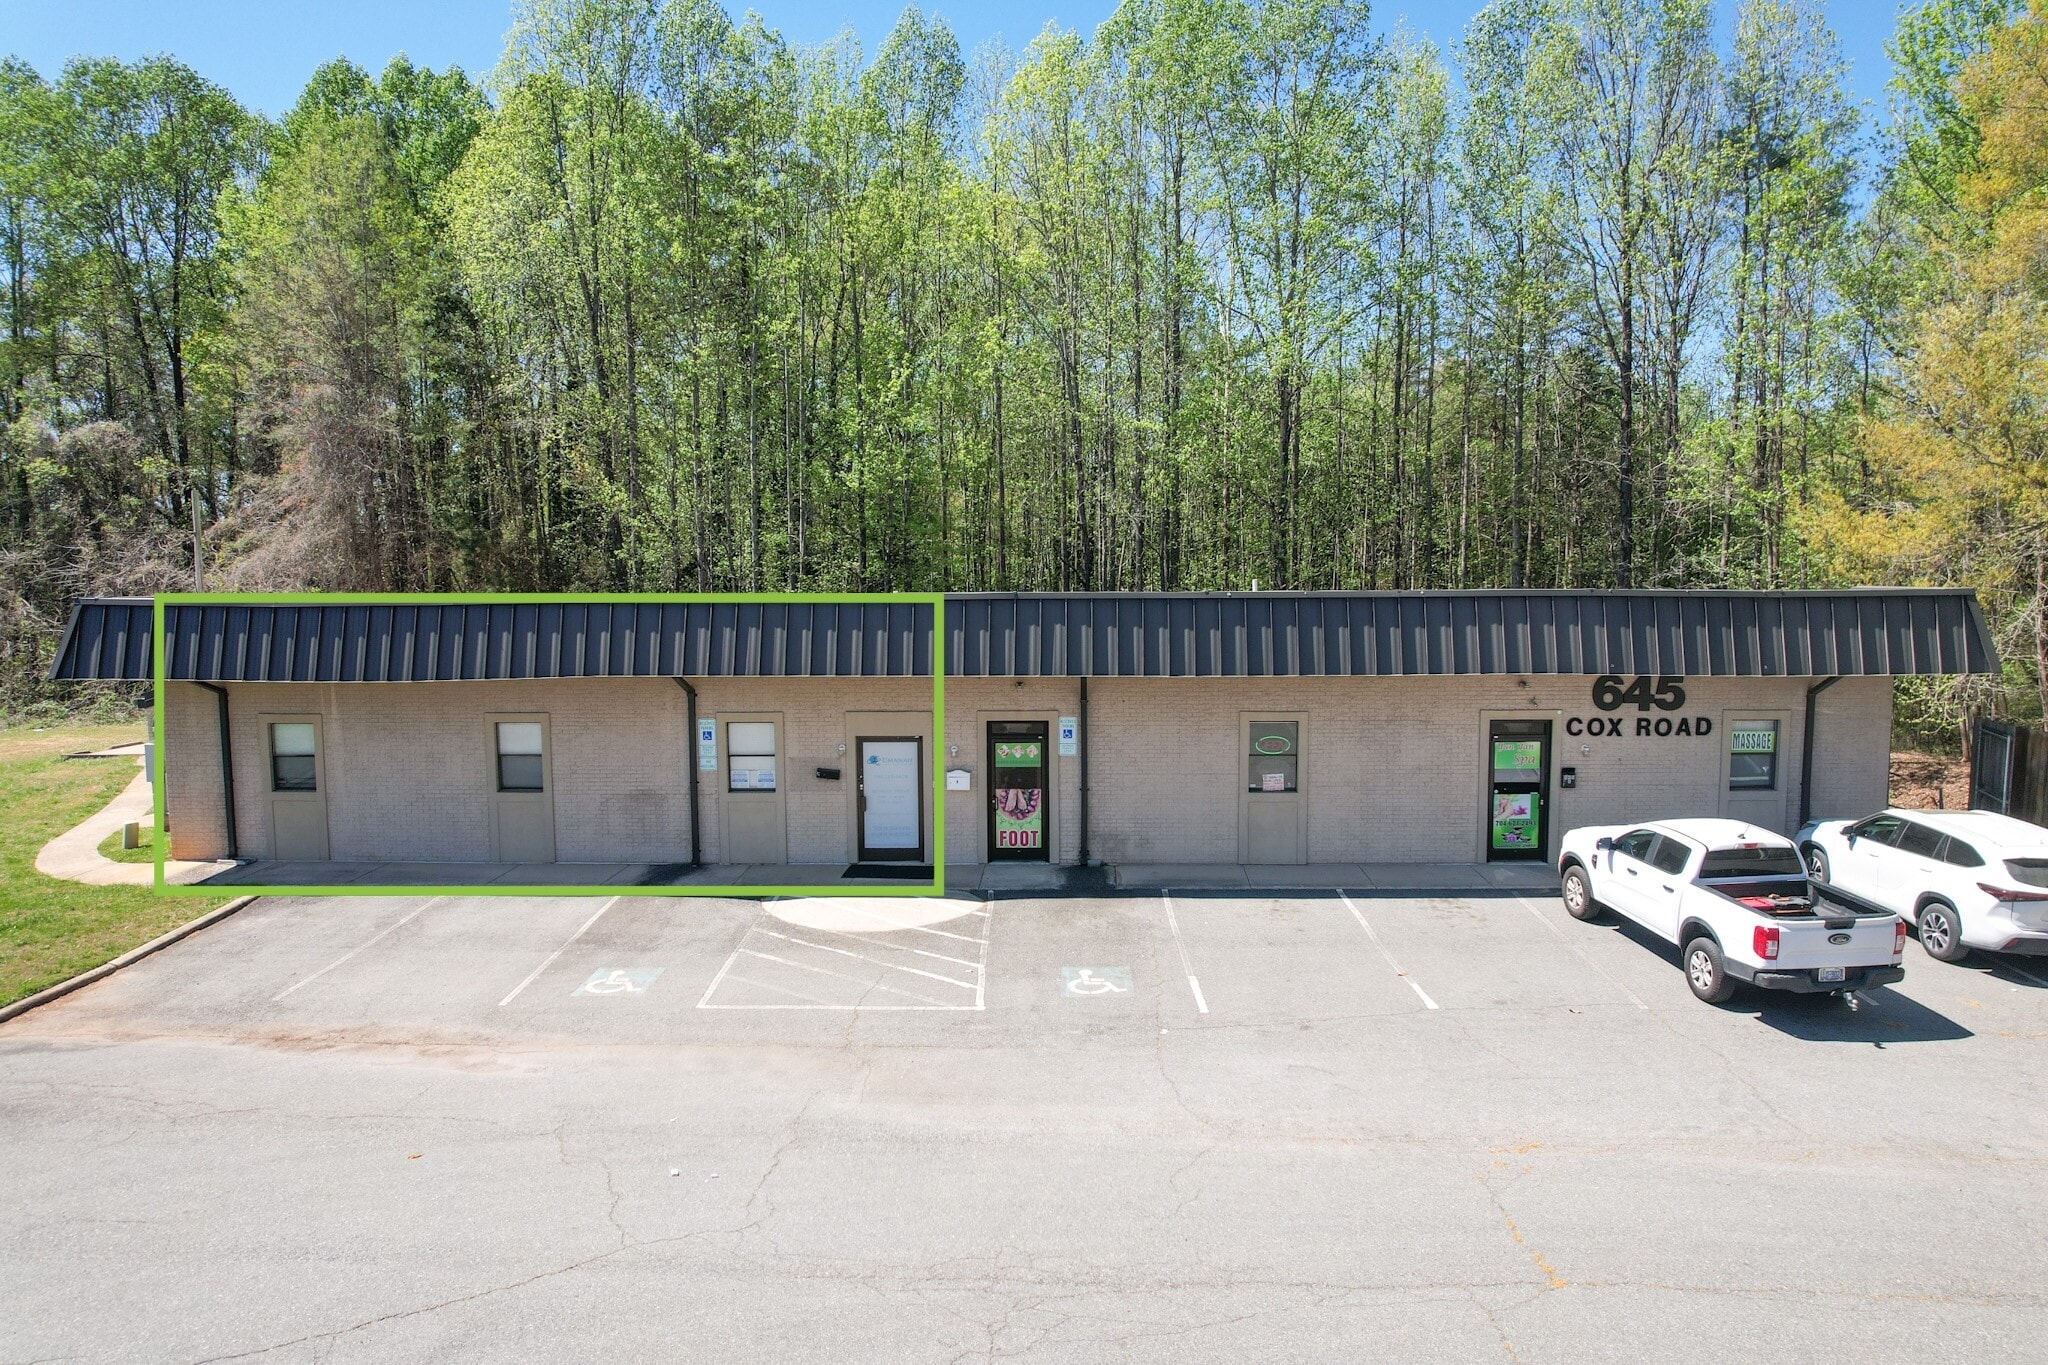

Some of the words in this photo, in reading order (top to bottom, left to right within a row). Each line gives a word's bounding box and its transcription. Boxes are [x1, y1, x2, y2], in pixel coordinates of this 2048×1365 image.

[1592, 675, 1686, 711] 645
[1566, 717, 1623, 737] COX
[1636, 717, 1712, 737] ROAD
[1732, 732, 1772, 750] MASSAGE
[1514, 753, 1536, 766] Spa
[999, 829, 1039, 847] FOOT
